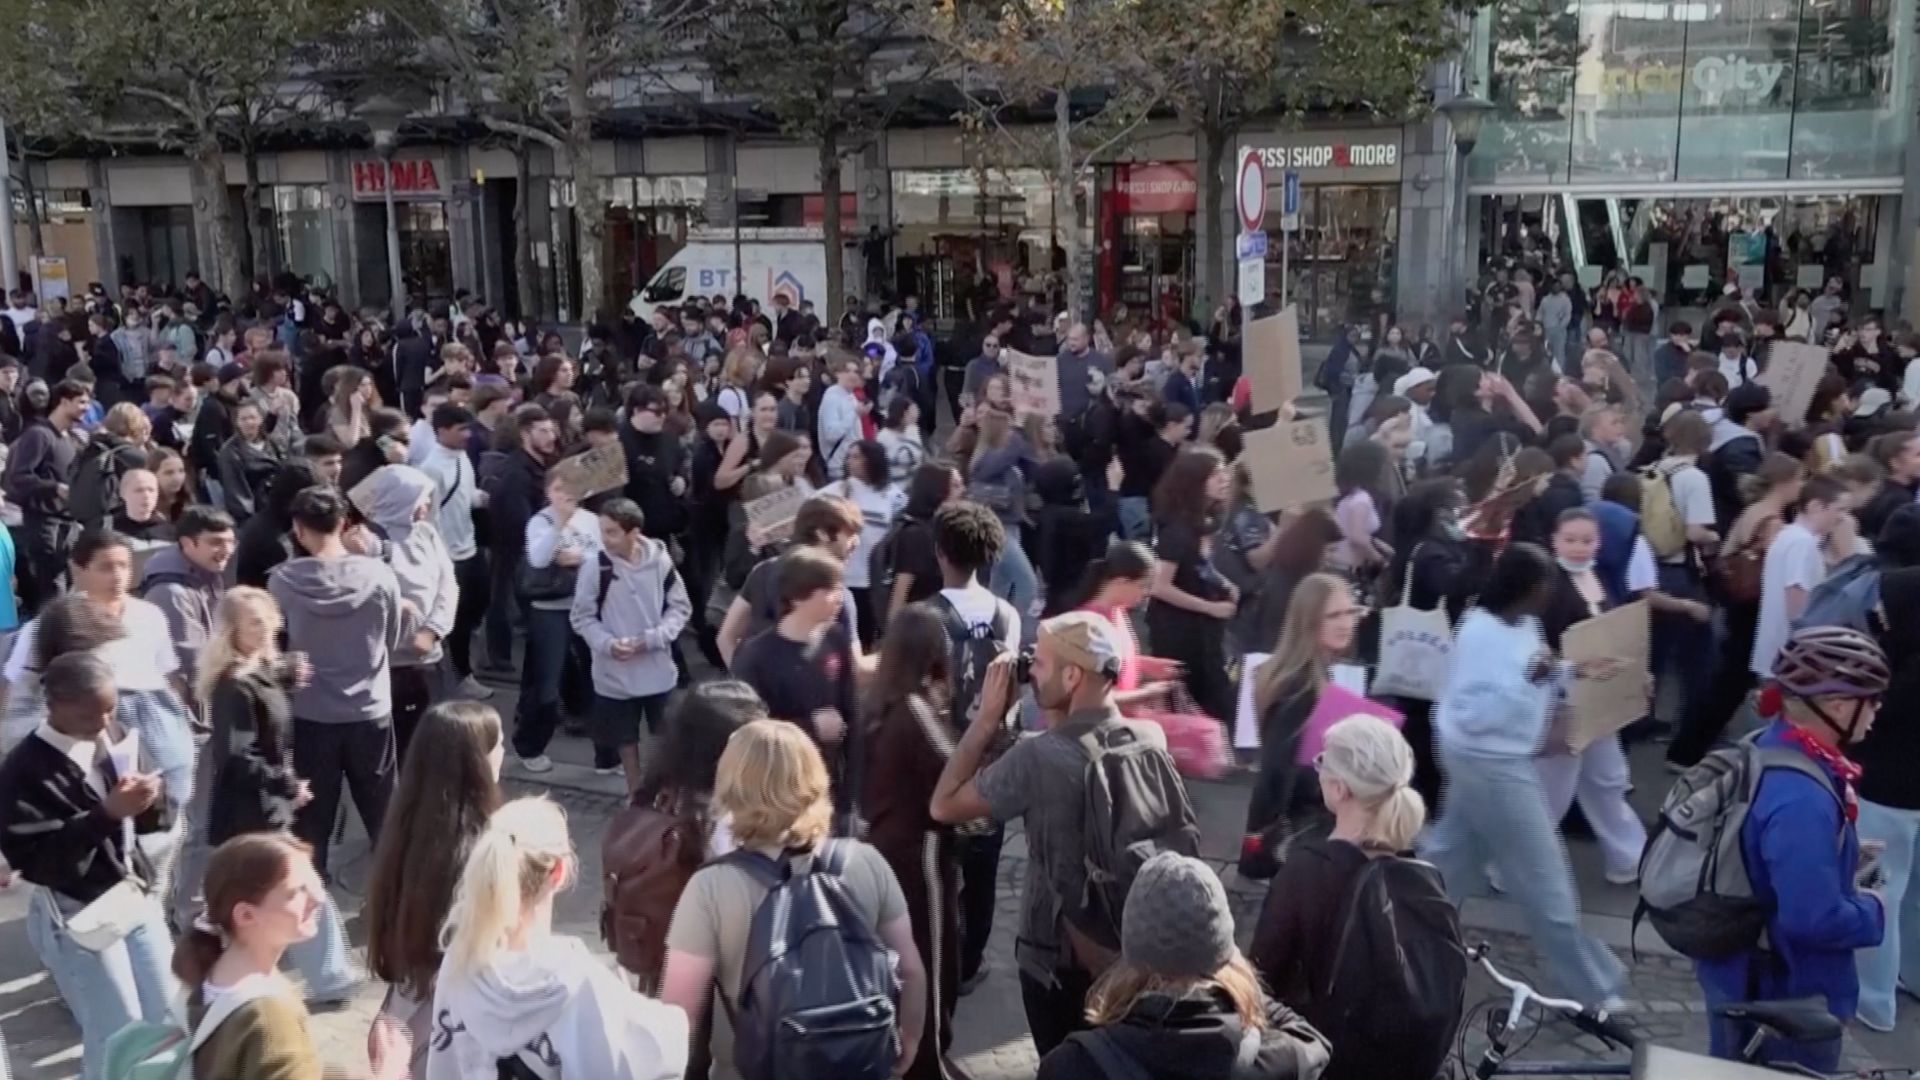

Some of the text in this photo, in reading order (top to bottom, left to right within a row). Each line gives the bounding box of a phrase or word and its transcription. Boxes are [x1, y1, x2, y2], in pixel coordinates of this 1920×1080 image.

[1692, 54, 1784, 98] City
[1293, 146, 1333, 167] SHOP
[700, 269, 731, 288] BT
